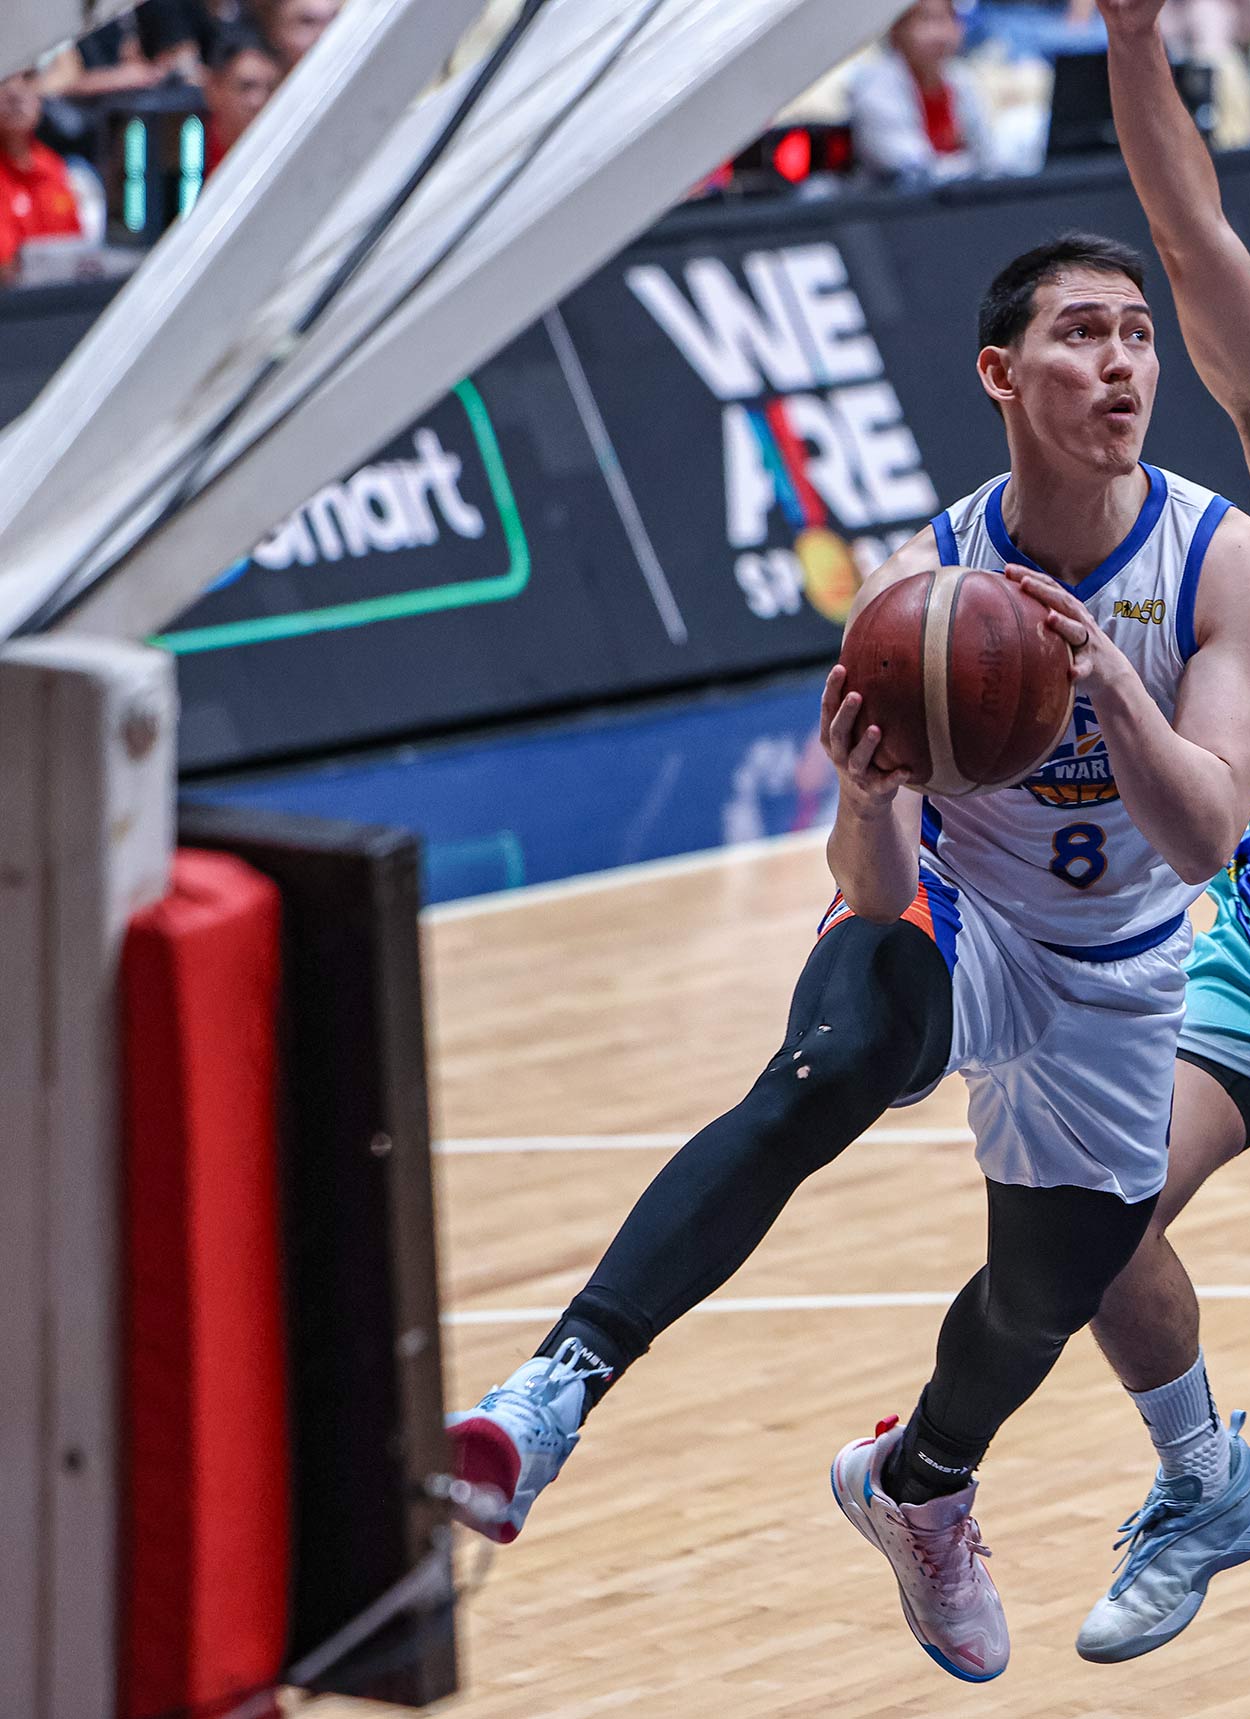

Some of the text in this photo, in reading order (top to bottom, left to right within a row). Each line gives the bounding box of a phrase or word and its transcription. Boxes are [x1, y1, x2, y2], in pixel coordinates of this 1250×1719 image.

[624, 241, 884, 400] WE
[721, 380, 941, 549] ARE
[1049, 822, 1108, 890] 8
